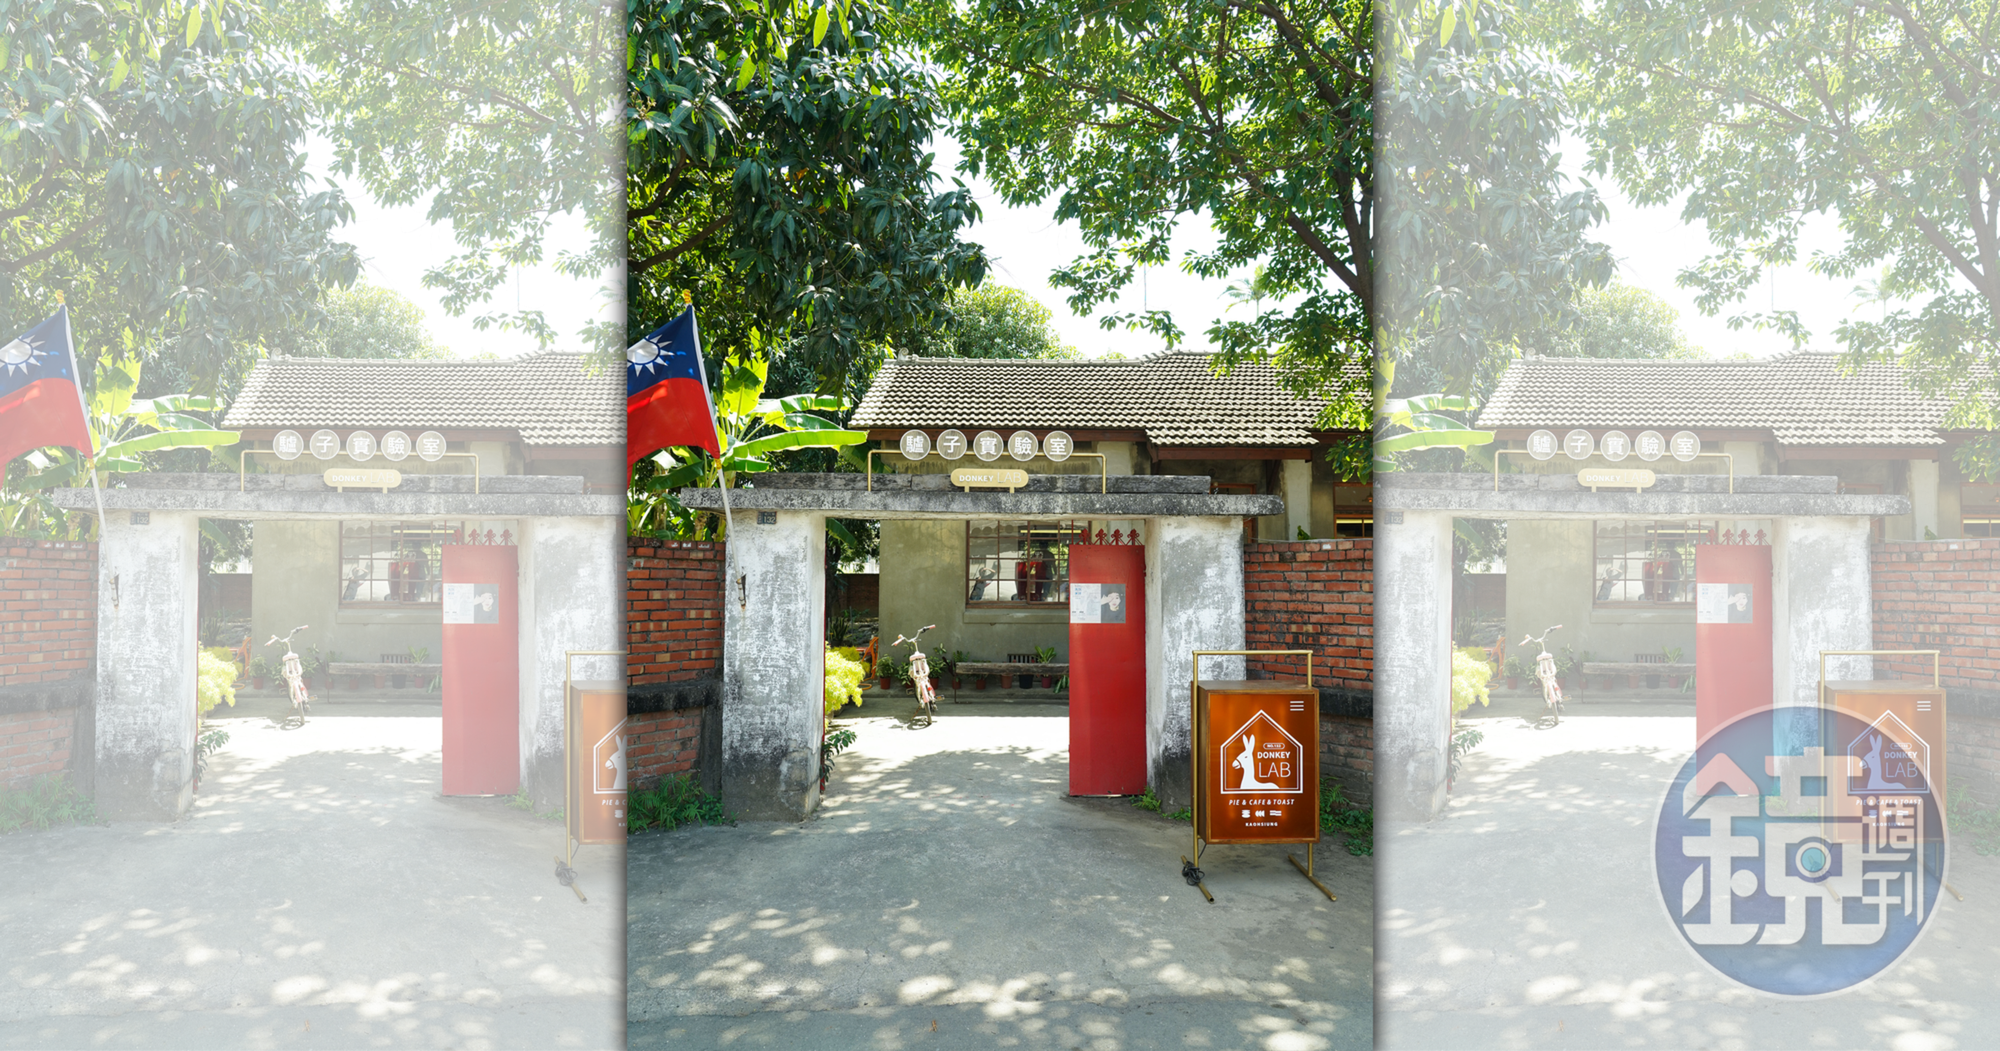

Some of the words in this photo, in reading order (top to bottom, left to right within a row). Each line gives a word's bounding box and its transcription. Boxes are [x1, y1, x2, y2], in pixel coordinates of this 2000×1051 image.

[906, 435, 1067, 456] 驢子實驗室
[332, 474, 367, 483] DONKEY
[959, 474, 994, 483] DONKEY
[997, 472, 1022, 483] LAB
[763, 516, 776, 524] 132
[1257, 751, 1291, 759] DONKEY
[1884, 751, 1918, 759] DONKEY
[1258, 761, 1291, 778] LAB
[1885, 761, 1918, 778] LAB
